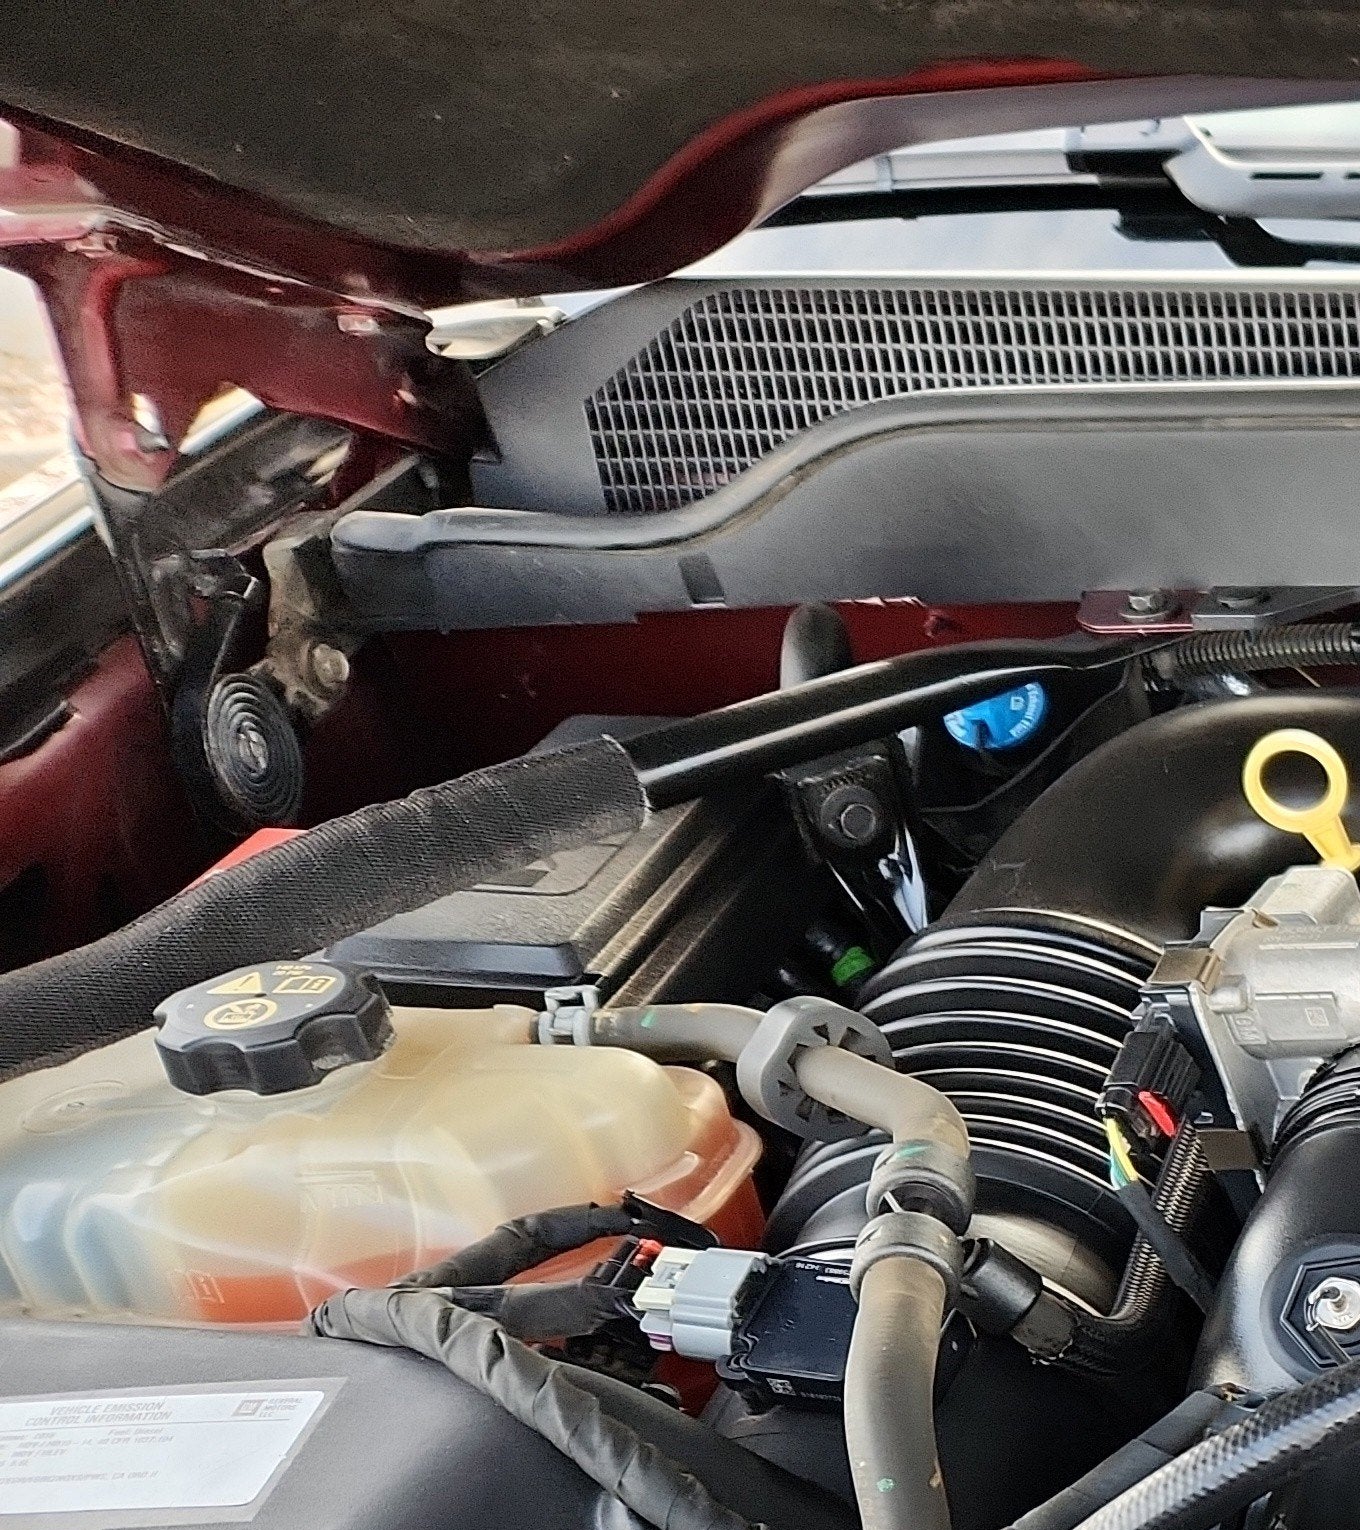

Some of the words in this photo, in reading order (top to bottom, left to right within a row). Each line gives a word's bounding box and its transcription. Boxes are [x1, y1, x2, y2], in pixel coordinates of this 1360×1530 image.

[50, 1404, 102, 1415] VEHICLE
[103, 1401, 165, 1413] EMISSION
[25, 1414, 82, 1427] CONTROL
[85, 1410, 173, 1424] INFORMATION
